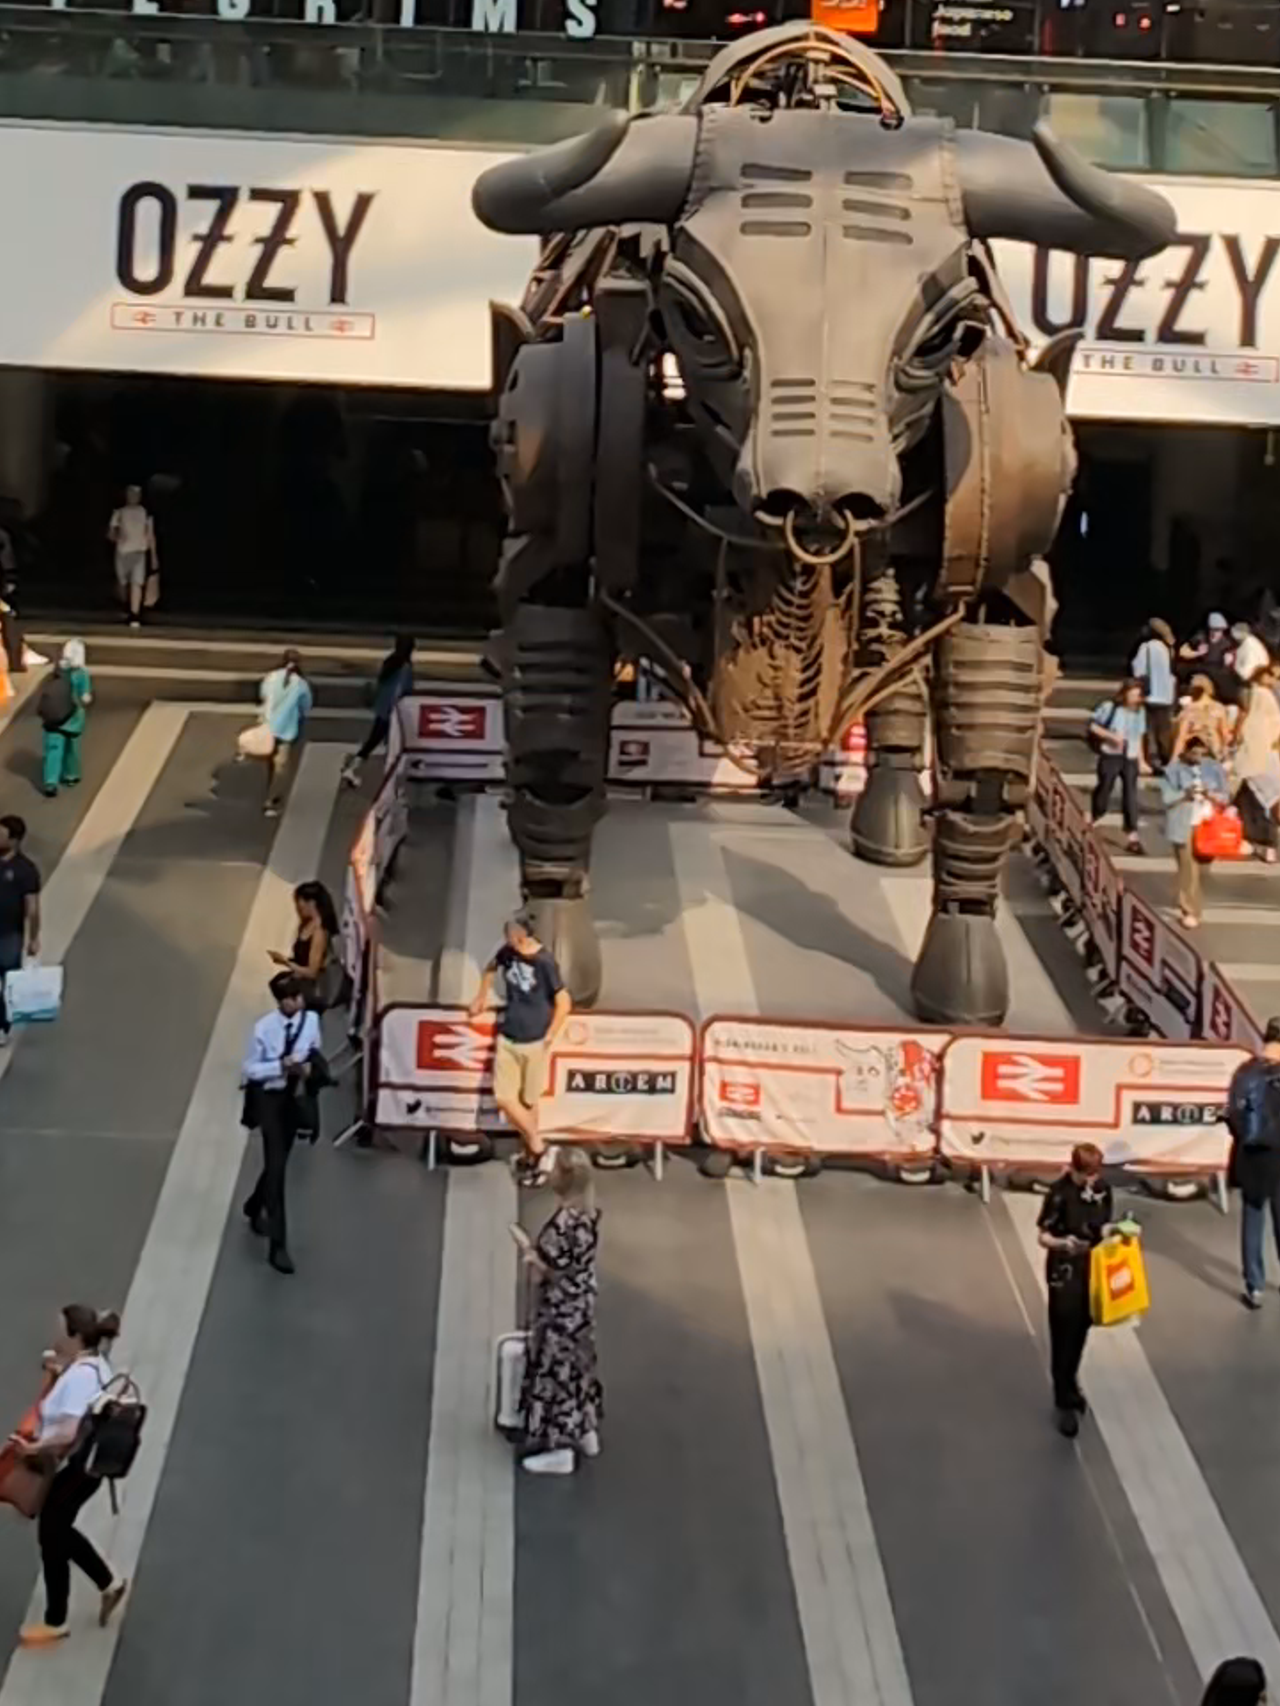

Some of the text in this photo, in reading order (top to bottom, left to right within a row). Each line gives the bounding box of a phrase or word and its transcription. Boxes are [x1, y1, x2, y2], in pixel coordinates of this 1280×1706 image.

[116, 180, 378, 306] OZZY
[173, 310, 315, 333] THE BULL
[1082, 353, 1221, 375] THE BULL
